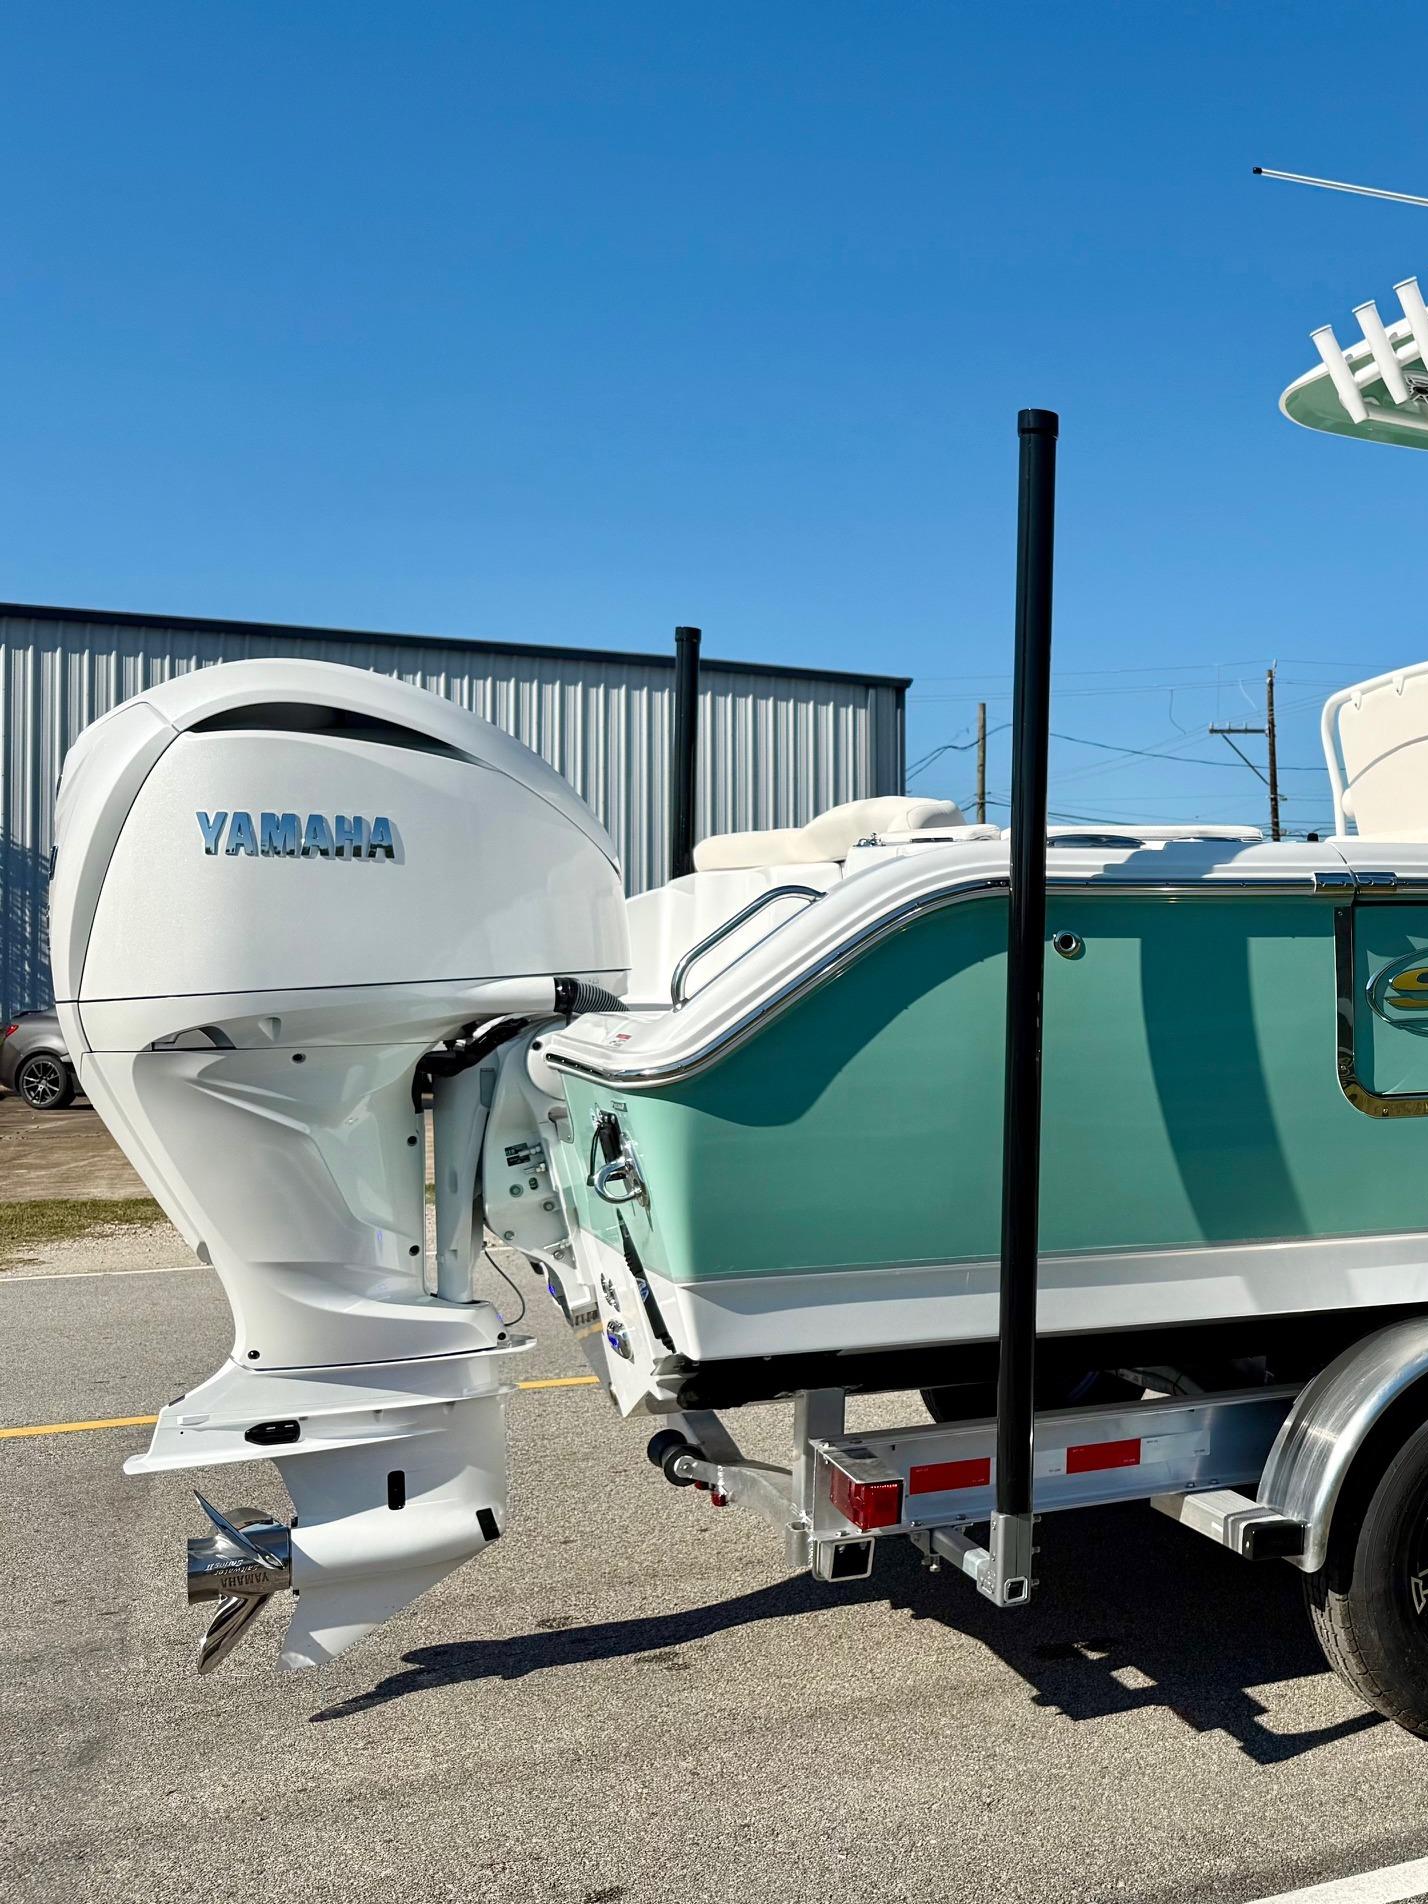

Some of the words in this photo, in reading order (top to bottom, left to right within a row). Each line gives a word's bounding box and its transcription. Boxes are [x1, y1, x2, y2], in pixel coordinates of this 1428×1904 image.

[196, 811, 396, 859] YAMAHA
[213, 1564, 260, 1576] Saltwater
[220, 1571, 270, 1588] YAMAHA
